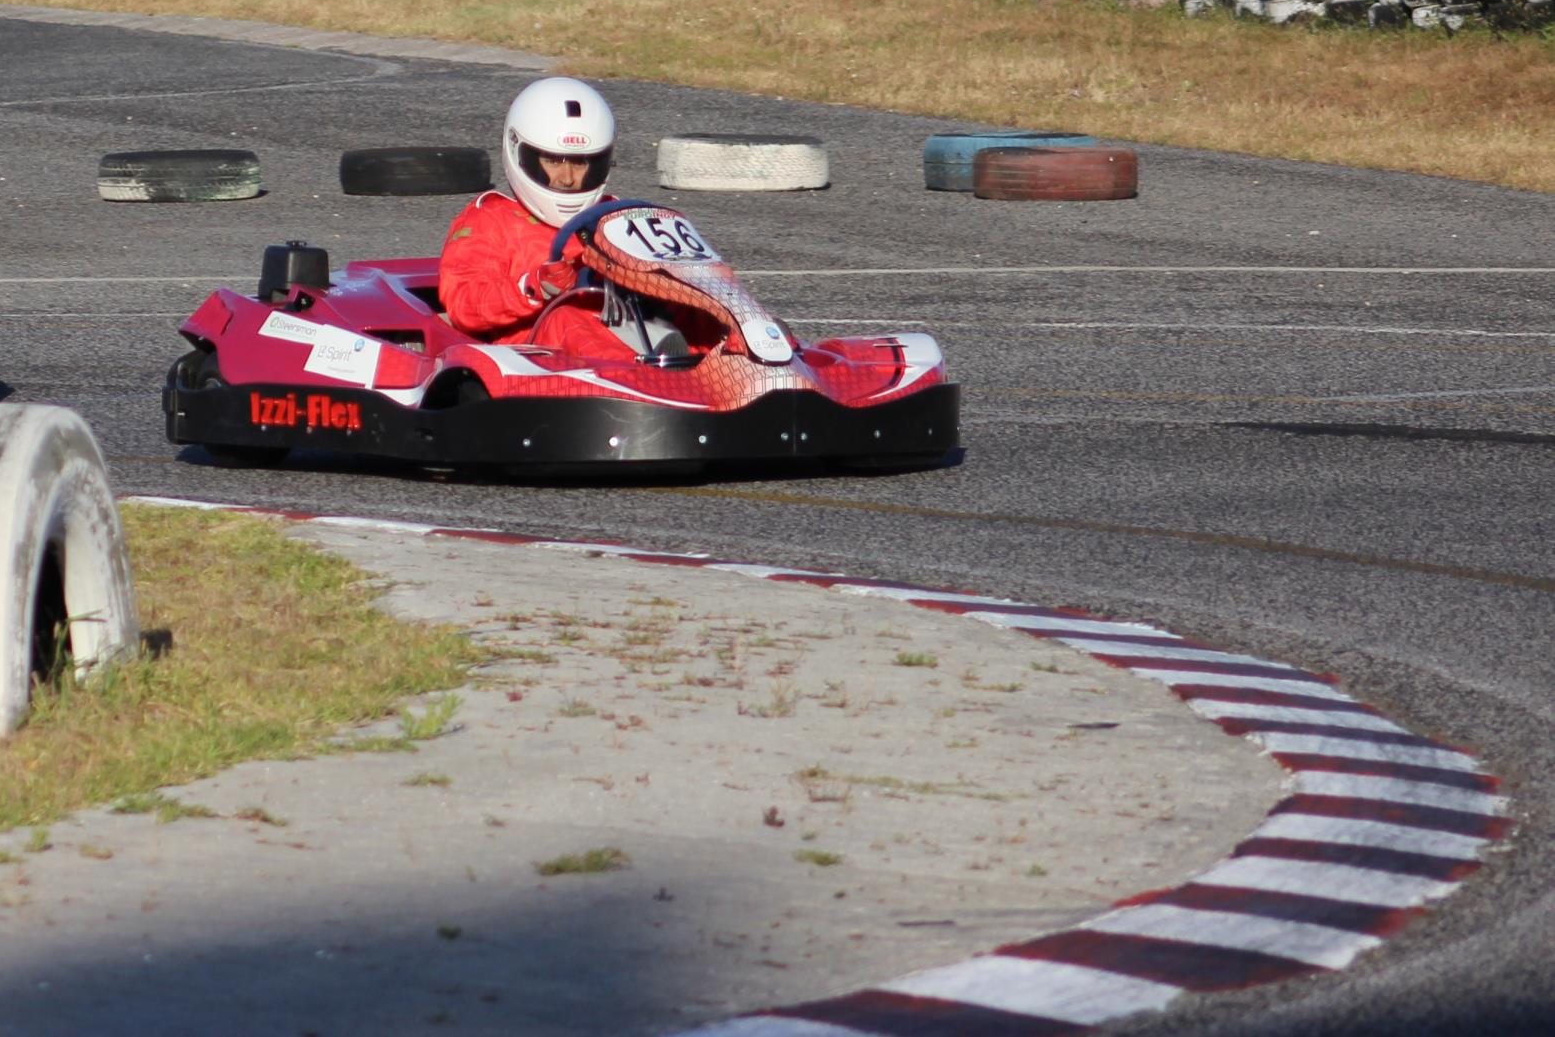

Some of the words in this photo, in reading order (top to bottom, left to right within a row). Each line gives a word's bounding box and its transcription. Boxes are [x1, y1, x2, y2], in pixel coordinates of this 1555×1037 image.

[563, 136, 587, 144] BELL
[626, 217, 705, 255] 156
[250, 391, 362, 430] Izzi-Flex
